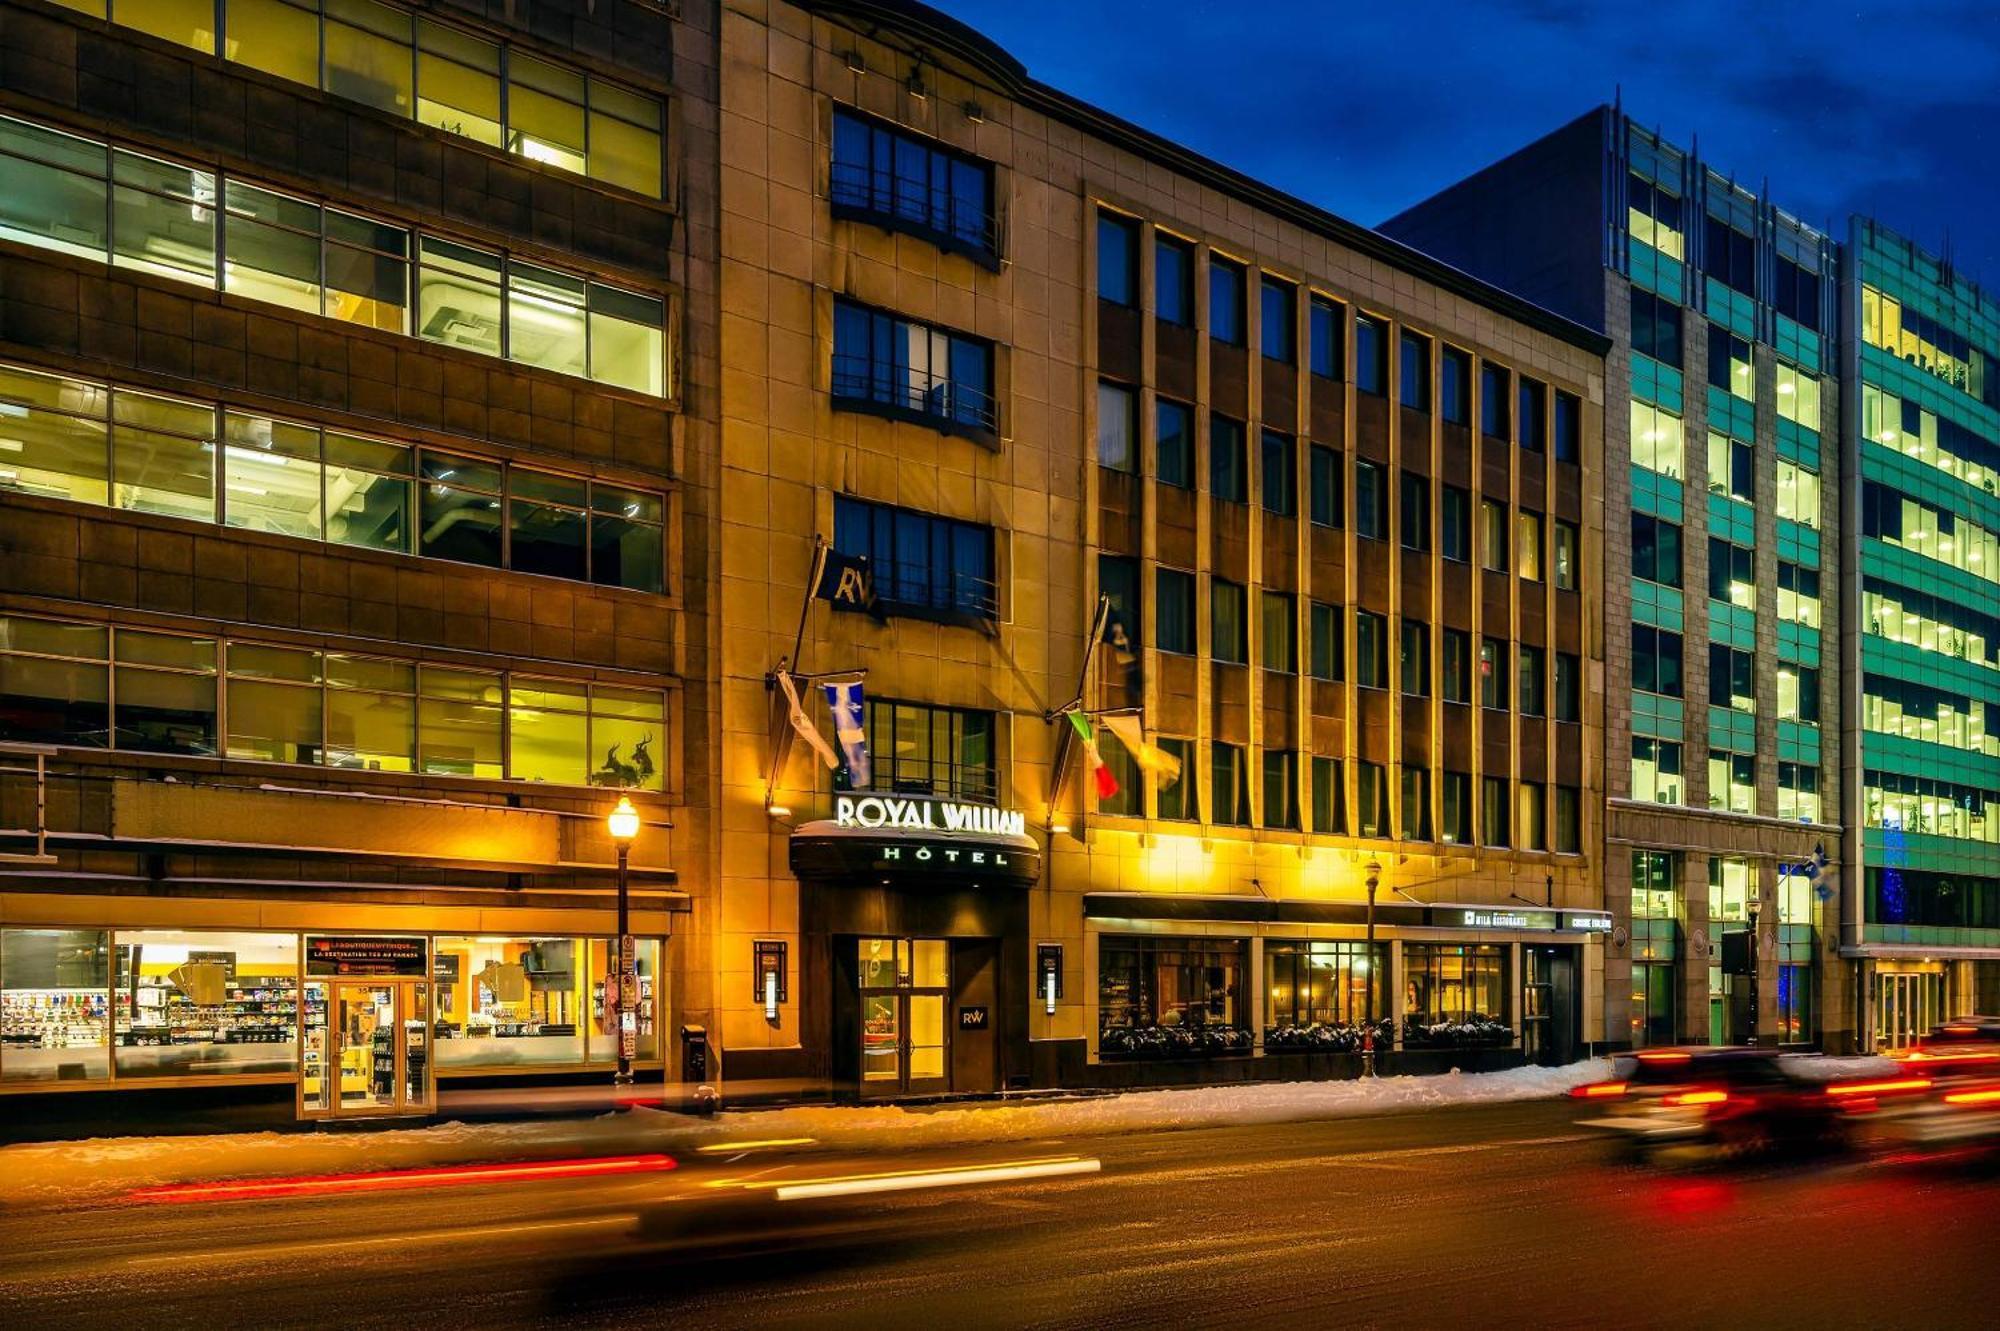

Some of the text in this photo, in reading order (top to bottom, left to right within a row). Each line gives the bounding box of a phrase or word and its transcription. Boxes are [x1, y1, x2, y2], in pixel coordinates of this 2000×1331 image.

[838, 797, 1025, 837] ROYAL WILLIAM
[884, 846, 1008, 865] HÔTEL
[963, 1012, 984, 1024] RW
